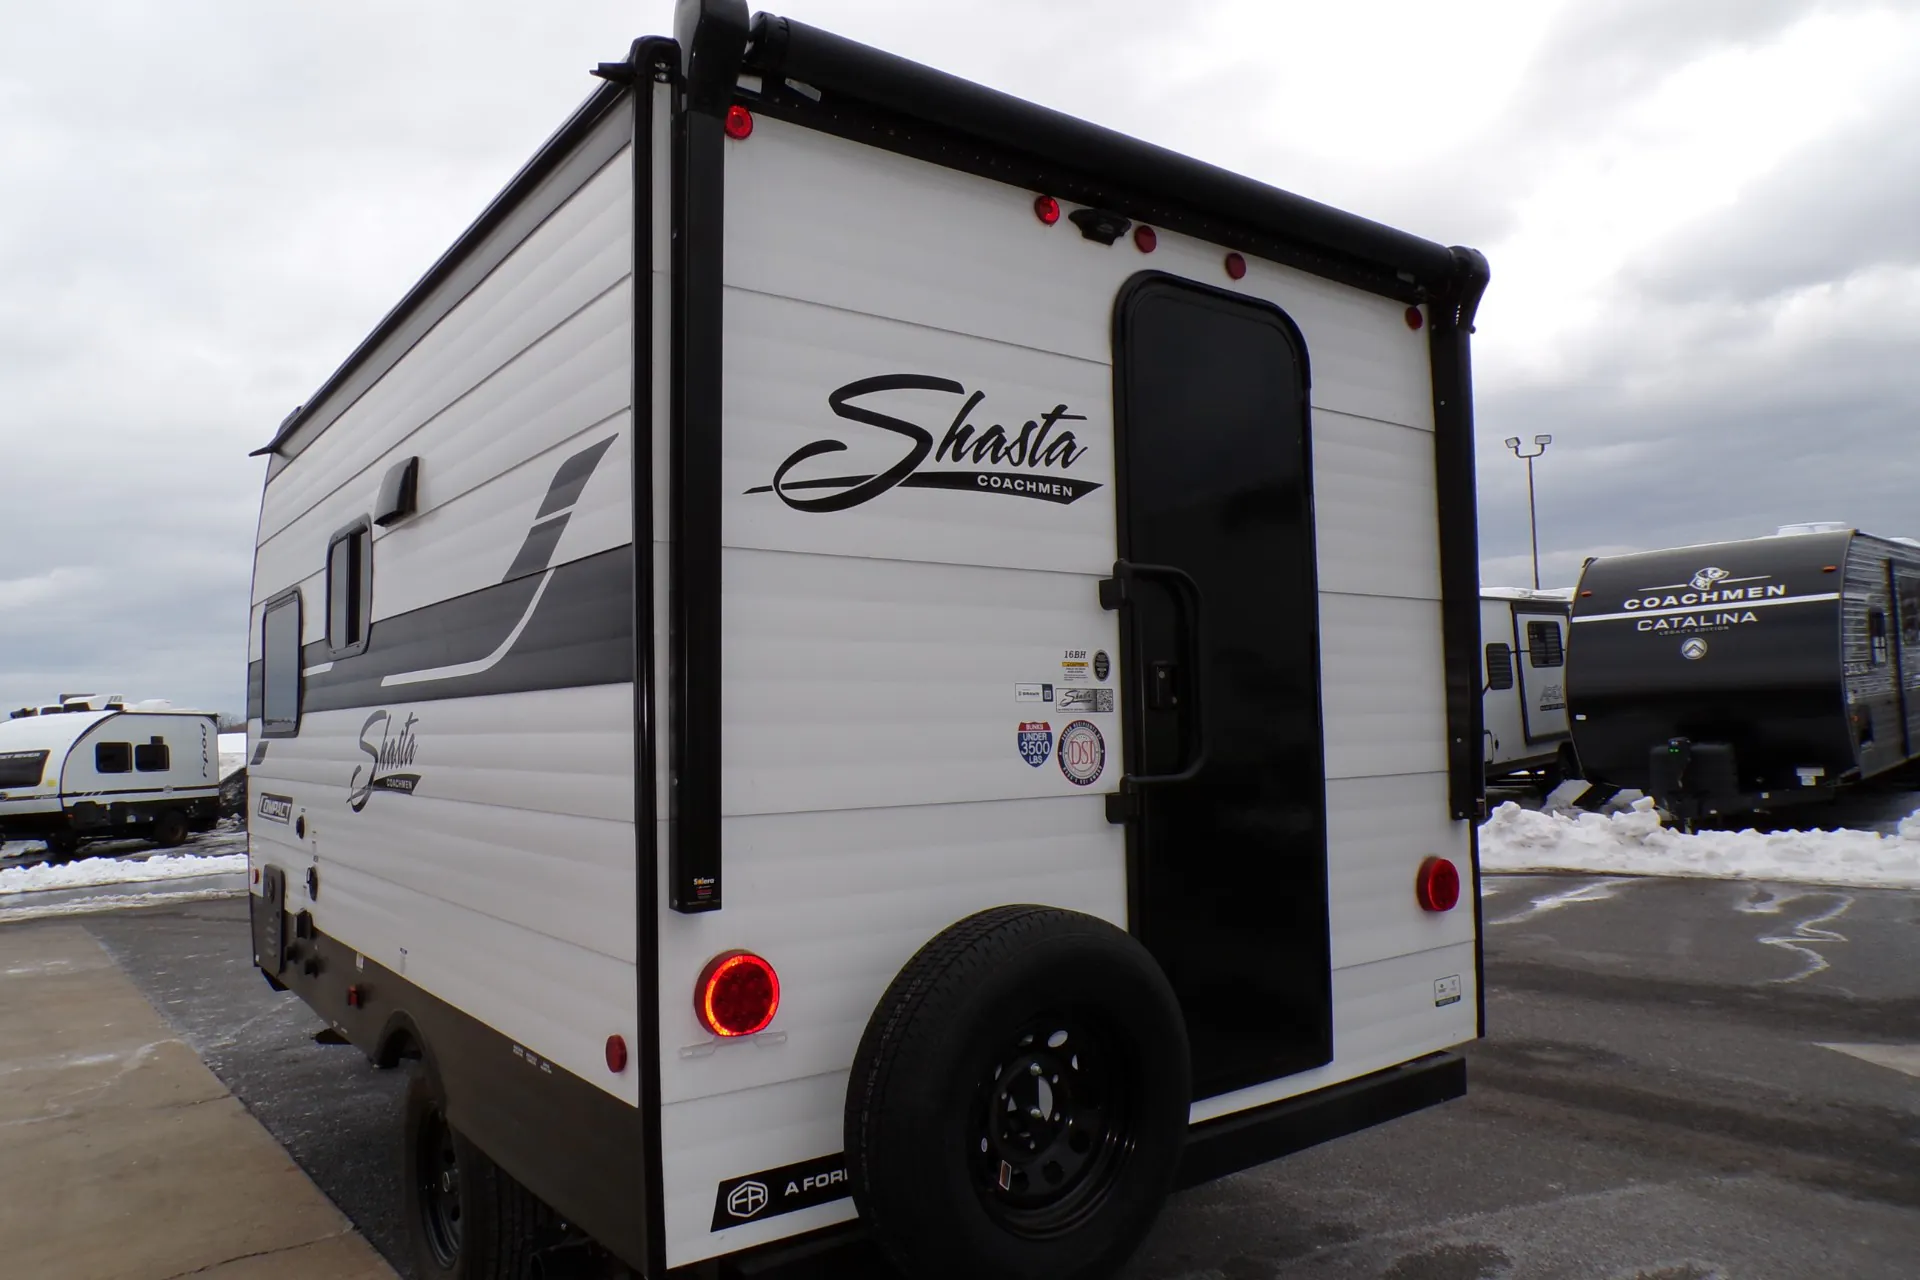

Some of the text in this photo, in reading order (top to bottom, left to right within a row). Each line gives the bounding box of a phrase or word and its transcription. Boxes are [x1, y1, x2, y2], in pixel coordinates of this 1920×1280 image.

[772, 374, 1088, 513] Shasta
[976, 474, 1074, 498] COACHMEN
[1623, 584, 1787, 611] COACHMEN
[1637, 611, 1759, 632] CATALINA
[1064, 650, 1087, 659] 16BH
[1020, 741, 1050, 756] 3500
[1022, 732, 1047, 741] UNDER
[350, 709, 420, 813] Shasta
[1029, 755, 1043, 764] LBS
[1070, 740, 1095, 765] DSI
[386, 778, 413, 790] COACHMEN
[260, 795, 292, 822] COMPACT
[784, 1168, 849, 1197] A FOR
